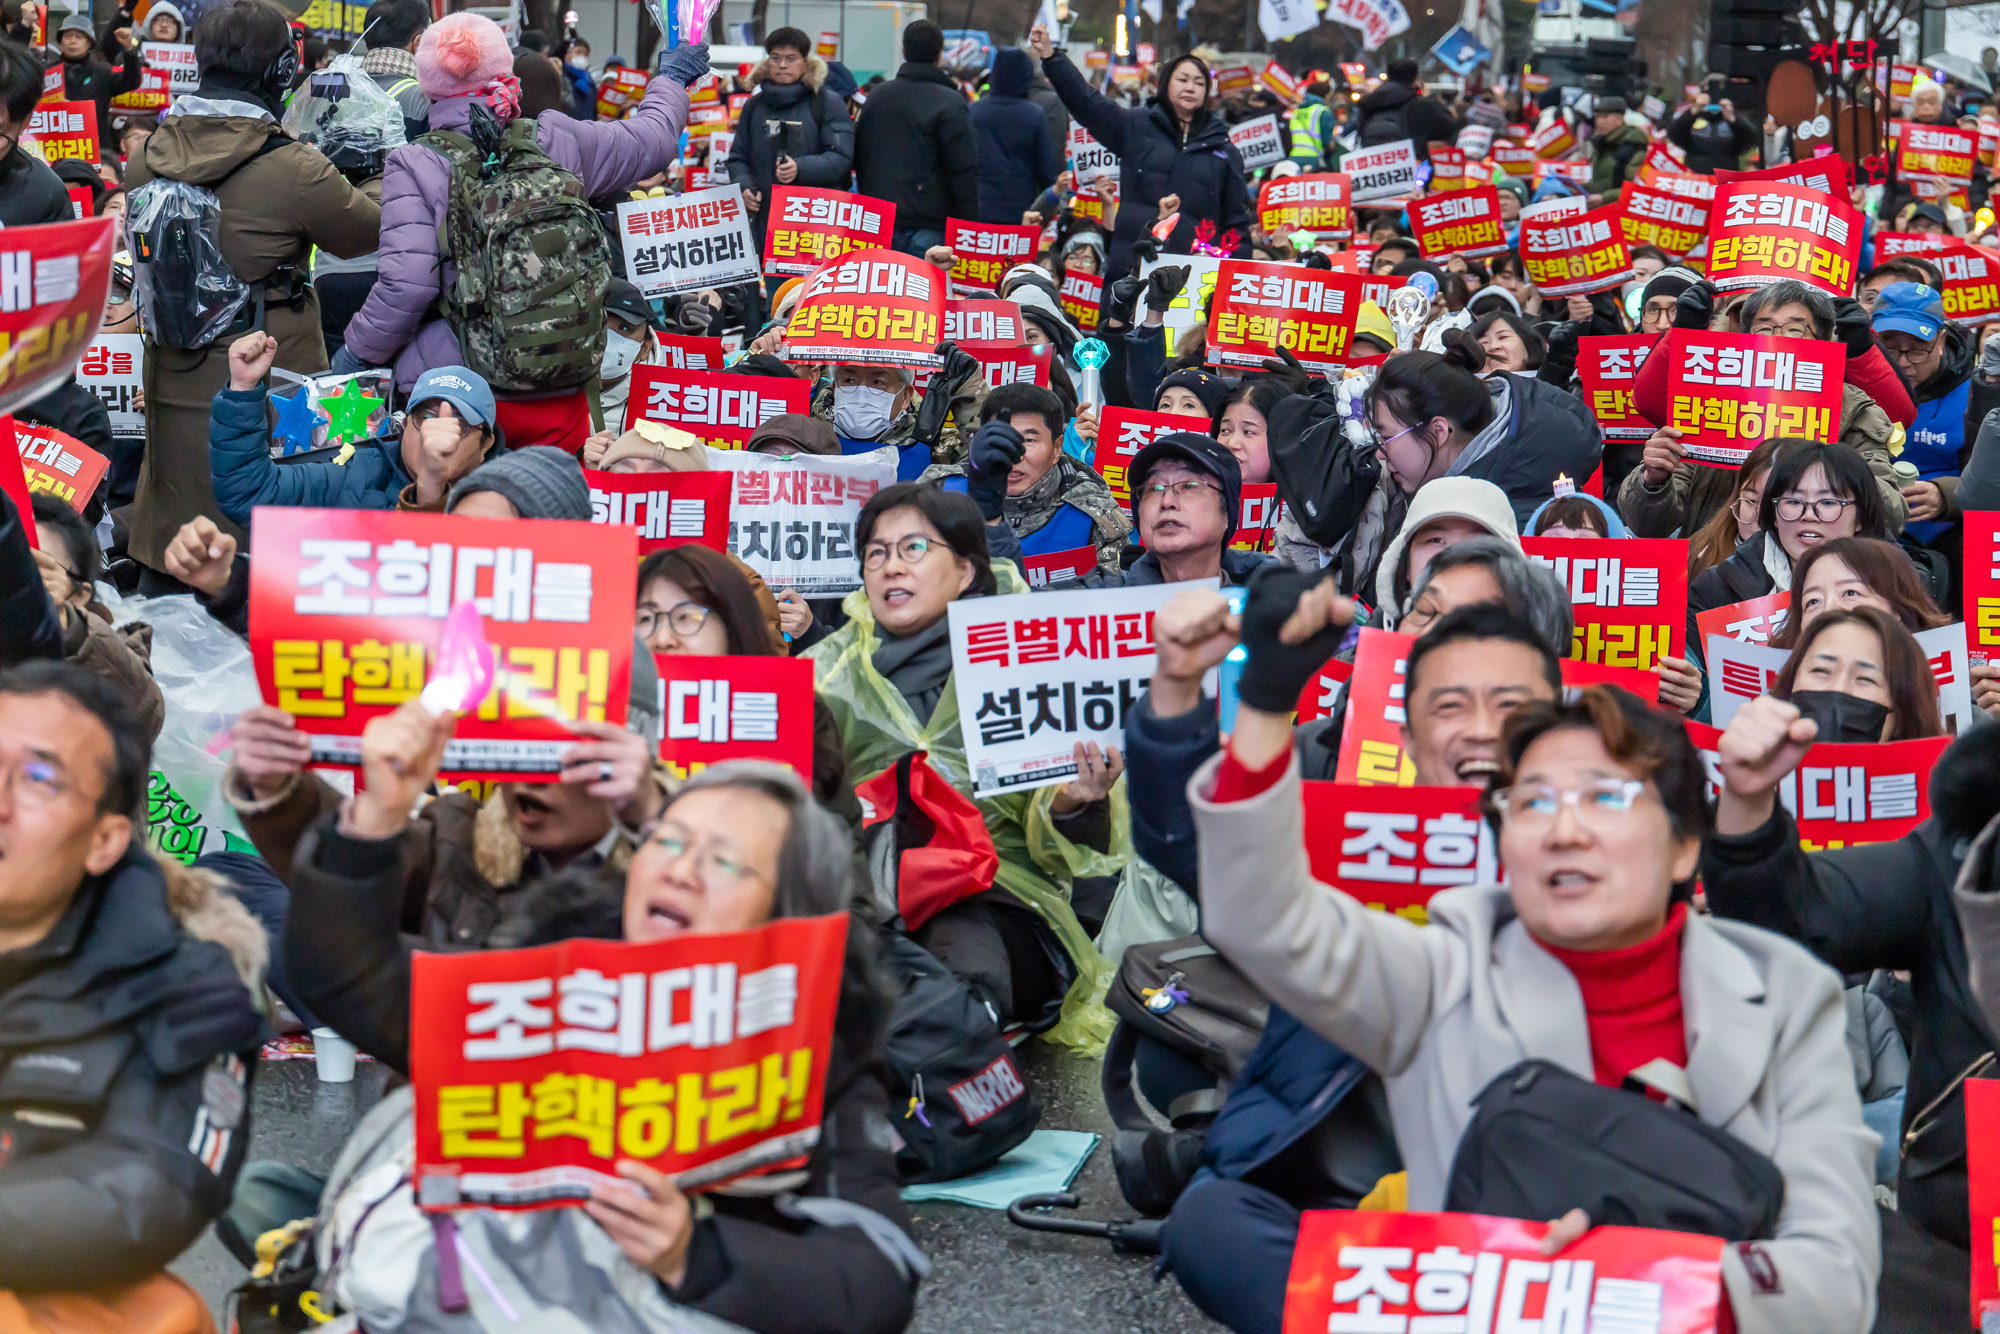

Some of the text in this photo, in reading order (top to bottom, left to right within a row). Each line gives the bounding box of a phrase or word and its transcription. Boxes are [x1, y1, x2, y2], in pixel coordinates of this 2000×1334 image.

[145, 49, 196, 64] 특별재판
[1809, 38, 1878, 73] 처단
[26, 110, 84, 133] 희대를
[21, 138, 94, 161] 핵하라!
[1345, 149, 1409, 171] 특별재판부
[1267, 181, 1341, 205] 조희대를
[1420, 196, 1490, 227] 조희대를
[1627, 192, 1707, 226] 조희대를
[627, 197, 740, 236] 특별재판부
[783, 196, 882, 234] 조희대를
[1262, 206, 1347, 231] 탄핵하라!
[1724, 193, 1849, 246] 조희대를
[633, 231, 745, 276] 설치하라!
[955, 228, 1031, 256] 조희대를
[1422, 220, 1500, 253] 탄핵하라!
[1527, 219, 1612, 252] 조희대를
[806, 261, 930, 302] 조희대를
[1526, 243, 1626, 282] 탄핵하라!
[1711, 235, 1850, 291] 탄핵하라!
[1062, 276, 1102, 303] 희대를
[1229, 272, 1345, 314] 조희대를
[1942, 284, 1999, 313] 하라!
[786, 304, 938, 345] 탄핵하라!
[944, 310, 1016, 340] 희대를
[1217, 312, 1348, 356] 탄핵하라!
[428, 375, 473, 393] BROOKLYN
[1682, 345, 1823, 393] 조희대를
[1673, 395, 1831, 444] 탄핵하라!
[737, 470, 879, 508] 별재판부
[294, 539, 593, 623] 조희대를
[967, 610, 1156, 669] 특별재판
[273, 638, 610, 723] 탄핵라!
[464, 962, 798, 1061] 조희대를
[438, 1048, 813, 1158] 탄핵하라!
[1328, 1246, 1662, 1334] 조희대를
